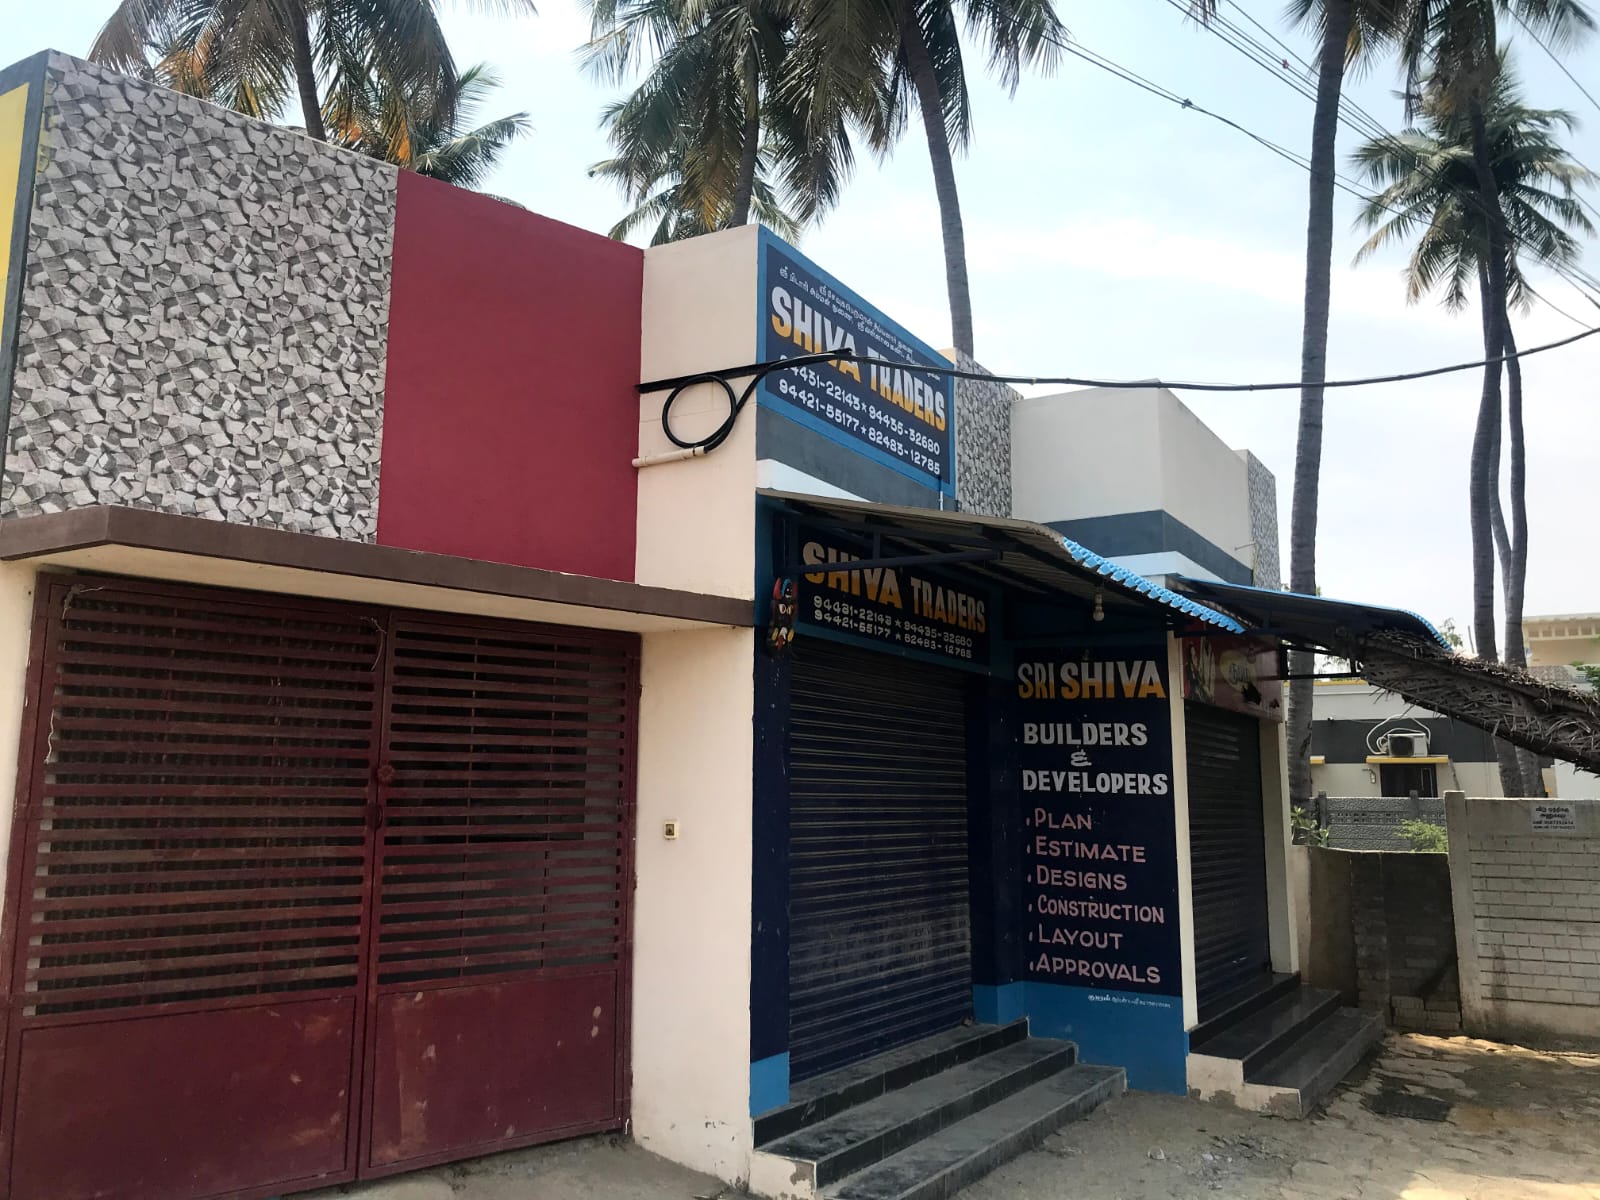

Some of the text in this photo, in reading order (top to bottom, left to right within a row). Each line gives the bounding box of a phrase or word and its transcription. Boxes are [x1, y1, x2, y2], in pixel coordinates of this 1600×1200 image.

[771, 286, 861, 383] SHIVA
[867, 345, 946, 431] TRADERS
[802, 541, 987, 634] SHIVA TRADERS
[1017, 660, 1167, 699] SRI SHIVA
[1023, 722, 1148, 746] BUILDERS
[1070, 749, 1092, 767] &
[1022, 769, 1169, 795] DEVELOPERS
[1034, 807, 1092, 830] PLAN
[1035, 835, 1147, 863] ESTIMATE
[1036, 864, 1128, 891] DESIGNS
[1037, 894, 1165, 924] CONSTRUCTION
[1038, 923, 1123, 950] LAYOUT
[1036, 952, 1161, 984] APPROVALS
